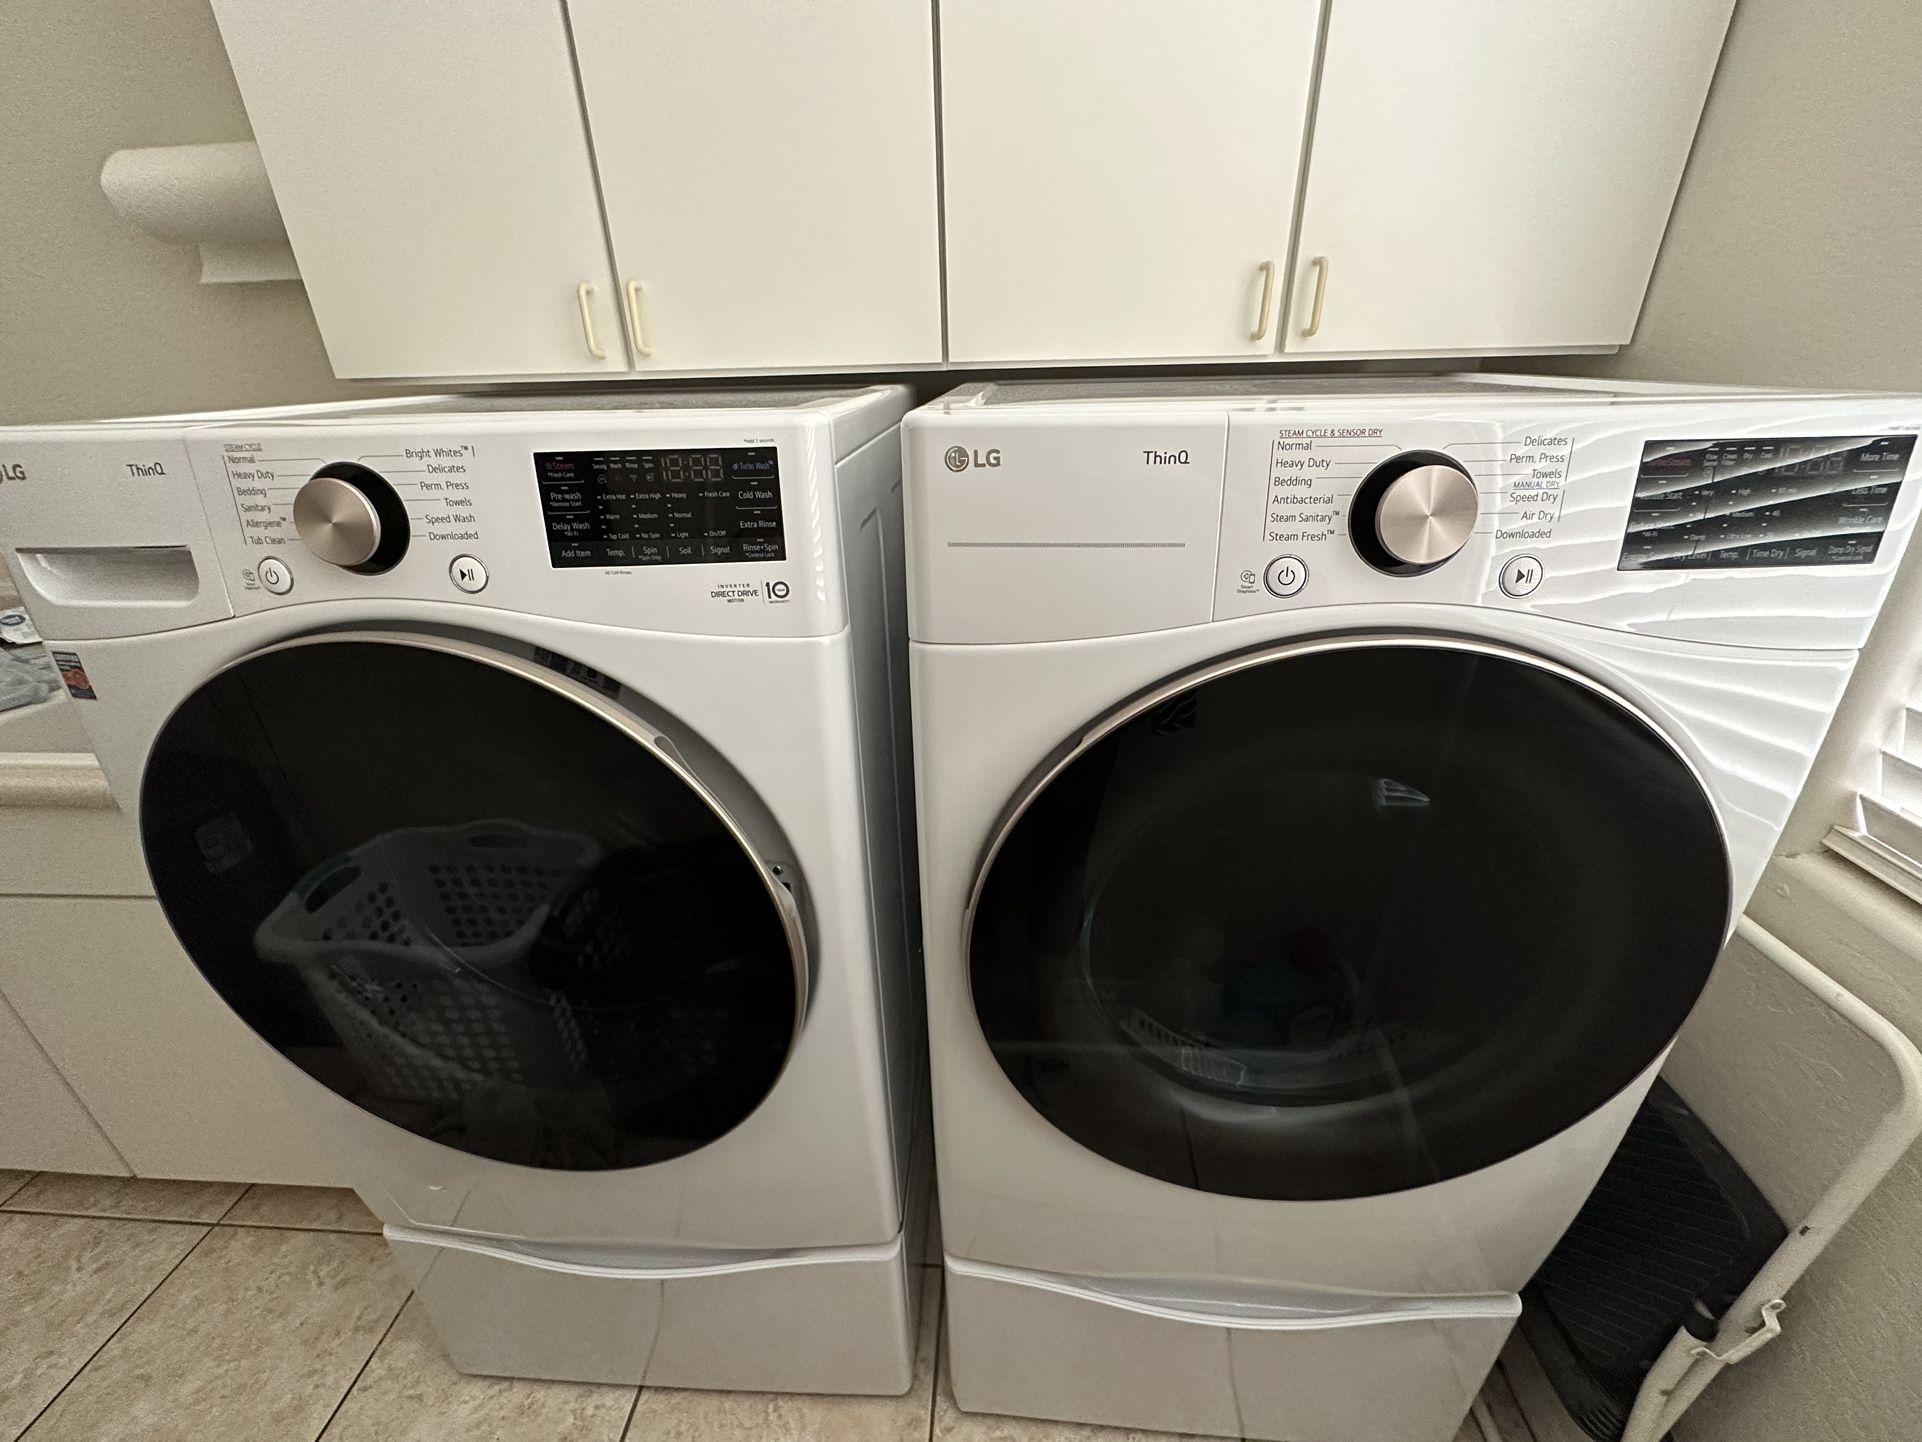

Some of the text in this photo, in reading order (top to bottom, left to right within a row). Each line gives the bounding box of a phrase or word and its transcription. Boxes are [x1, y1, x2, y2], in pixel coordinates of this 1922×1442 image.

[1279, 428, 1383, 438] STEAM CYCLE & SENSOR DRY
[1277, 440, 1313, 451] Normal
[1524, 435, 1568, 447] Delicates
[227, 455, 256, 464] Normal
[405, 448, 431, 461] Bright
[973, 449, 1001, 468] LG
[1143, 449, 1190, 466] ThinQ
[1509, 452, 1565, 464] Perm. Press
[1860, 452, 1899, 461] More Time
[427, 463, 466, 474] Delicates
[1275, 457, 1331, 470] Heavy Duty
[4, 463, 27, 481] LG
[127, 462, 166, 478] ThinQ
[231, 469, 274, 481] Heavy Duty
[1532, 468, 1562, 479] Towels
[420, 480, 469, 491] Perm. Press
[1273, 476, 1313, 488] Bedding
[1513, 480, 1560, 489] MANUAL DRY
[236, 486, 267, 498] Bedding
[738, 490, 773, 499] Cold Wash
[1869, 485, 1888, 494] Time
[550, 492, 582, 500] Pre-wash
[671, 492, 687, 500] Heavy
[1271, 494, 1334, 505] Antibacterial
[1509, 491, 1558, 504] Speed Dry
[444, 497, 472, 507] Towels
[240, 503, 271, 514] Sanitary
[425, 513, 476, 525] Speed Wash
[1270, 512, 1296, 523] Steam
[1521, 510, 1555, 523] Air Dry
[552, 521, 590, 531] Delay Wash
[740, 520, 777, 529] Extra Rinse
[249, 535, 286, 545] Tub Clean
[428, 530, 479, 541] Downloaded
[1269, 531, 1299, 541] Steam
[1495, 529, 1552, 540] Downloaded
[606, 548, 625, 557] Temp.
[642, 546, 658, 555] Spin
[679, 546, 692, 554] Soil
[710, 545, 731, 556] Signal
[1752, 549, 1784, 559] Time Dry
[1794, 547, 1819, 559] Signal
[710, 589, 759, 598] DIRECT DRIVE
[765, 581, 790, 599] 10
